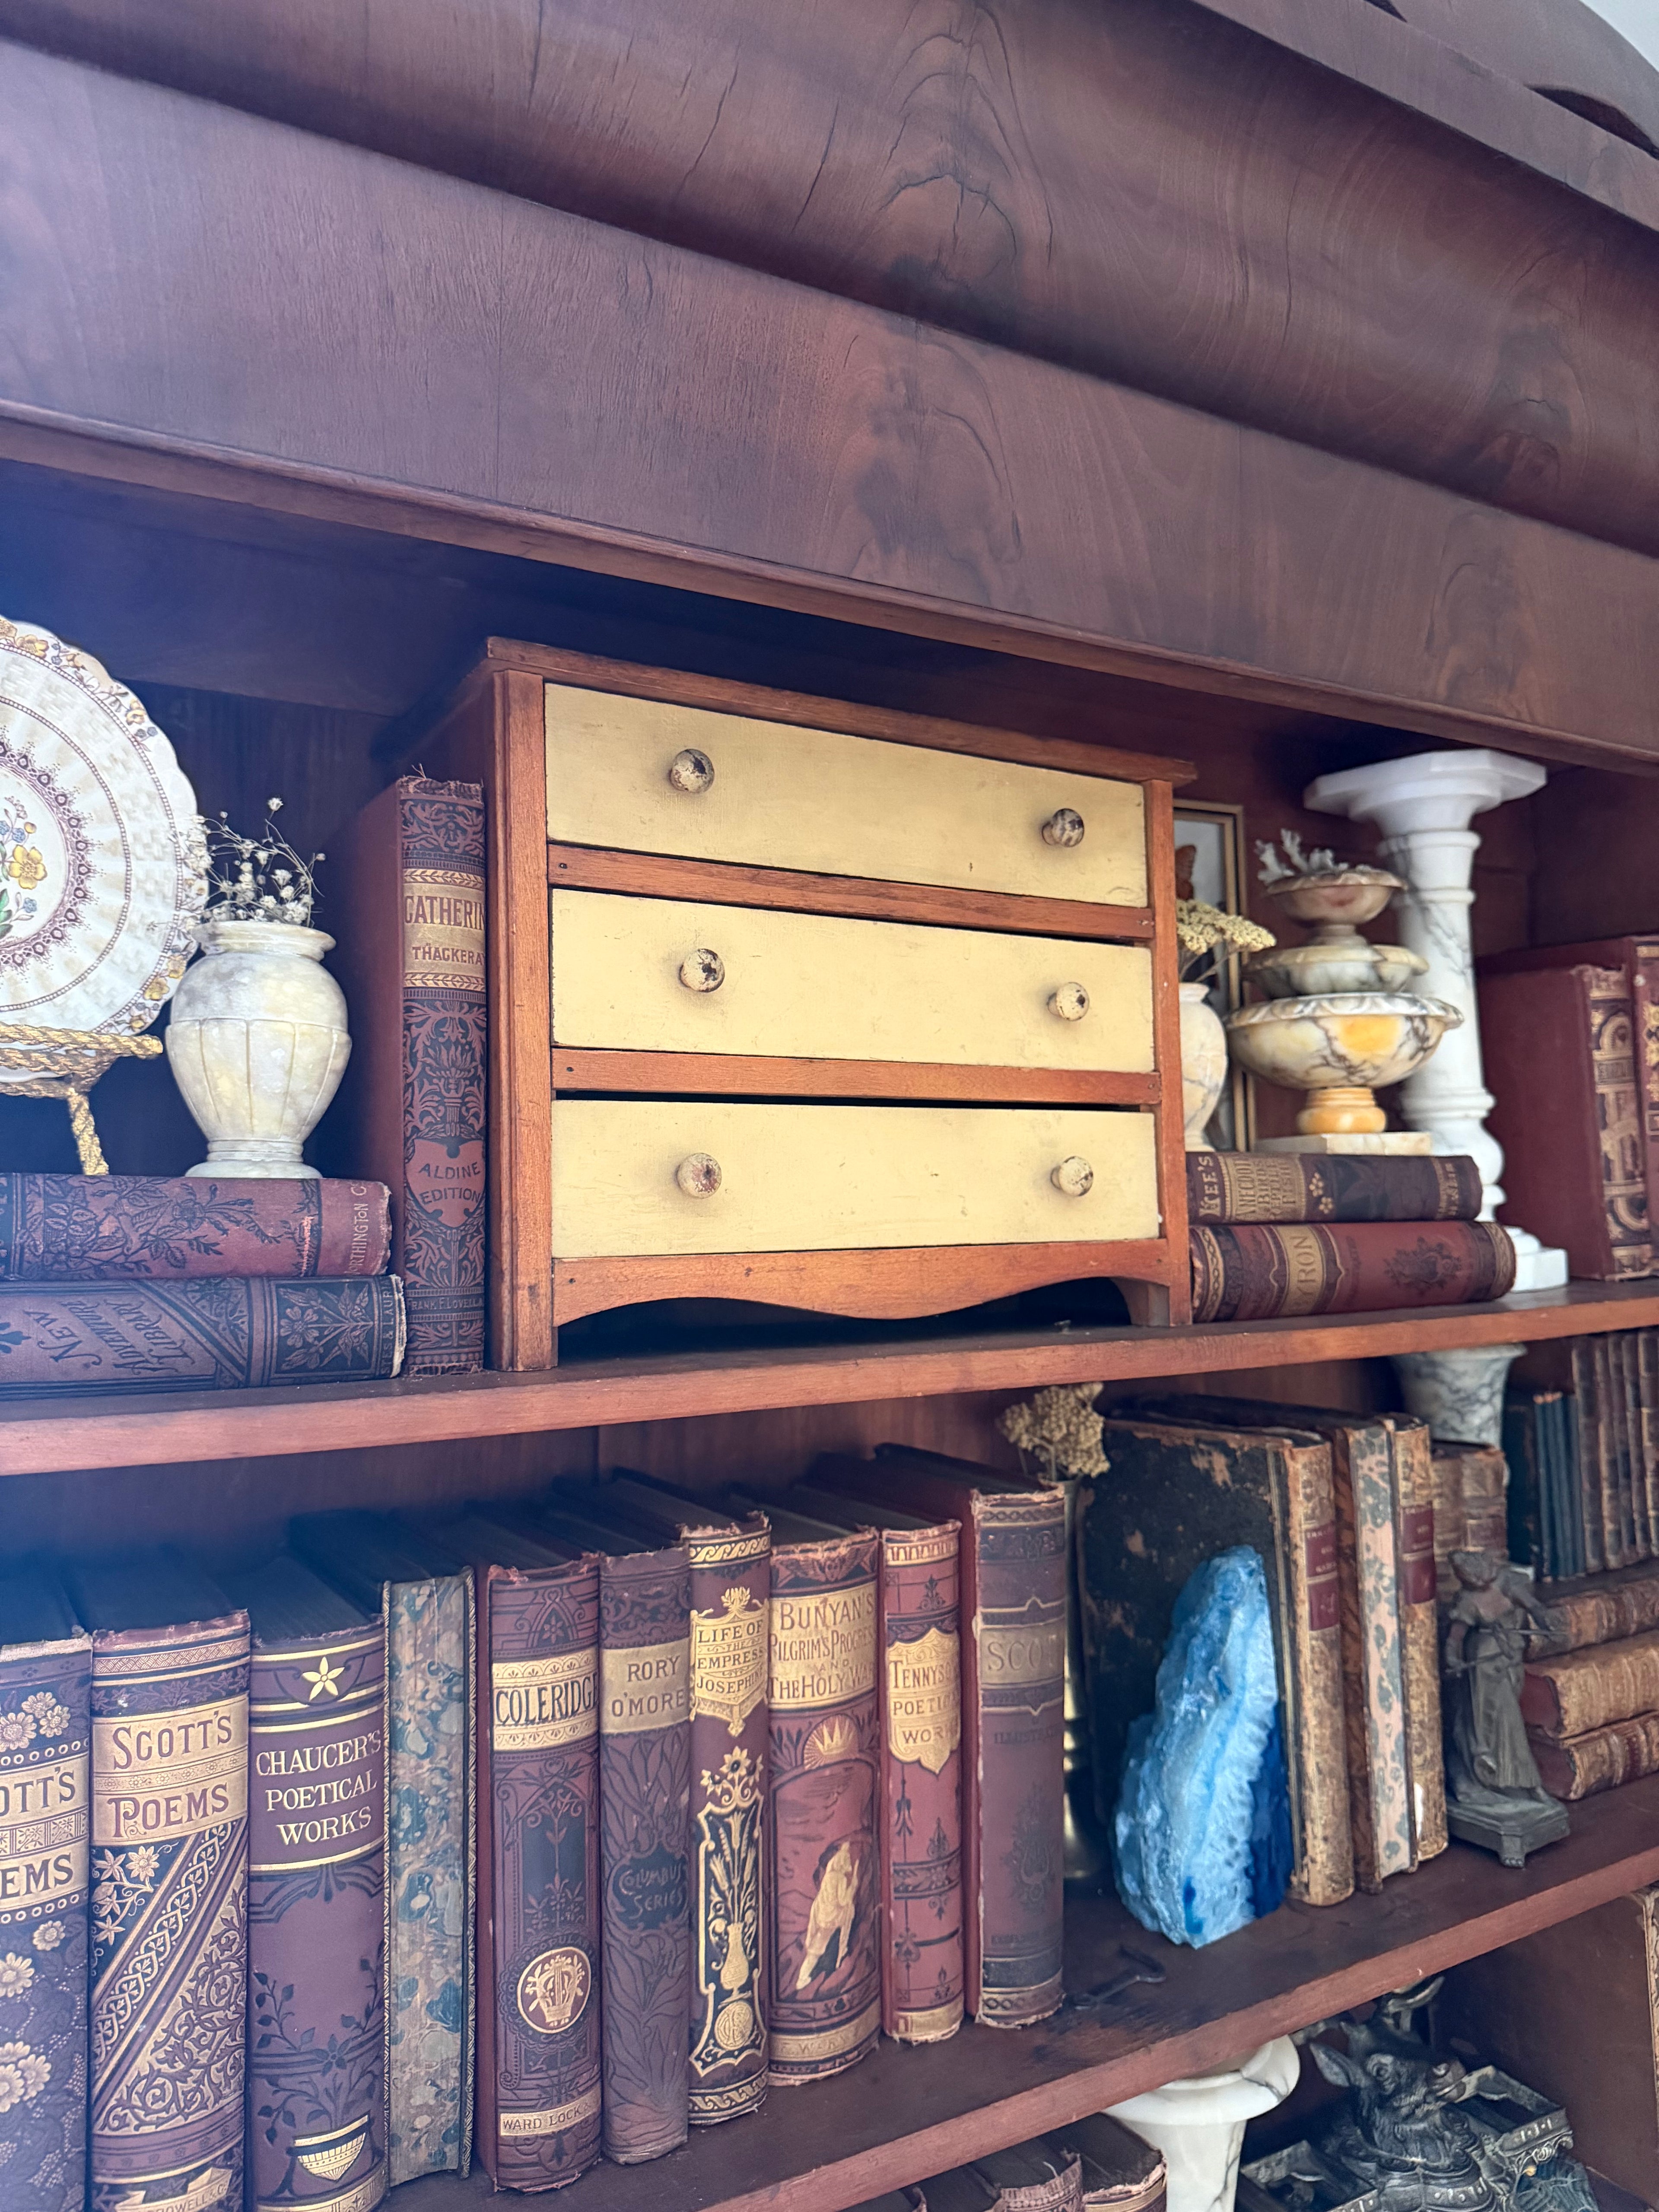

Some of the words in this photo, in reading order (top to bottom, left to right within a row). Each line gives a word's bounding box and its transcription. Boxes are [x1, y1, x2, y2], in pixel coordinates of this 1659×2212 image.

[405, 896, 485, 930] CATHERIN
[419, 1162, 480, 1180] ALDINE
[420, 1188, 481, 1205] EDITION
[23, 1309, 102, 1366] NEW
[60, 1301, 178, 1376] ADVENTURE
[104, 1300, 195, 1365] LIBRARY
[381, 1343, 393, 1374] STES
[780, 1593, 874, 1630] BUNYAN'S
[698, 1625, 743, 1643] LIFE
[747, 1619, 763, 1636] OF
[726, 1640, 745, 1652] THE
[770, 1633, 830, 1661] PILGRIM'S
[627, 1655, 680, 1683] RORY
[697, 1646, 764, 1669] EMPRESS
[819, 1659, 850, 1672] AND
[496, 1671, 598, 1726] COLERIDGE
[769, 1677, 800, 1700] THE
[801, 1673, 846, 1698] HOLY
[612, 1689, 685, 1718] O'MORE
[112, 1710, 232, 1770] SCOTT'S
[256, 1729, 381, 1777] CHAUCER'S
[265, 1770, 377, 1811] POETICAL
[107, 1783, 229, 1838] POEMS
[277, 1806, 372, 1846] WORKS
[619, 1863, 682, 1896] COLUMBUS
[628, 1886, 683, 1920] SERIES
[503, 2117, 542, 2130] WARD
[549, 2104, 582, 2126] LOCK
